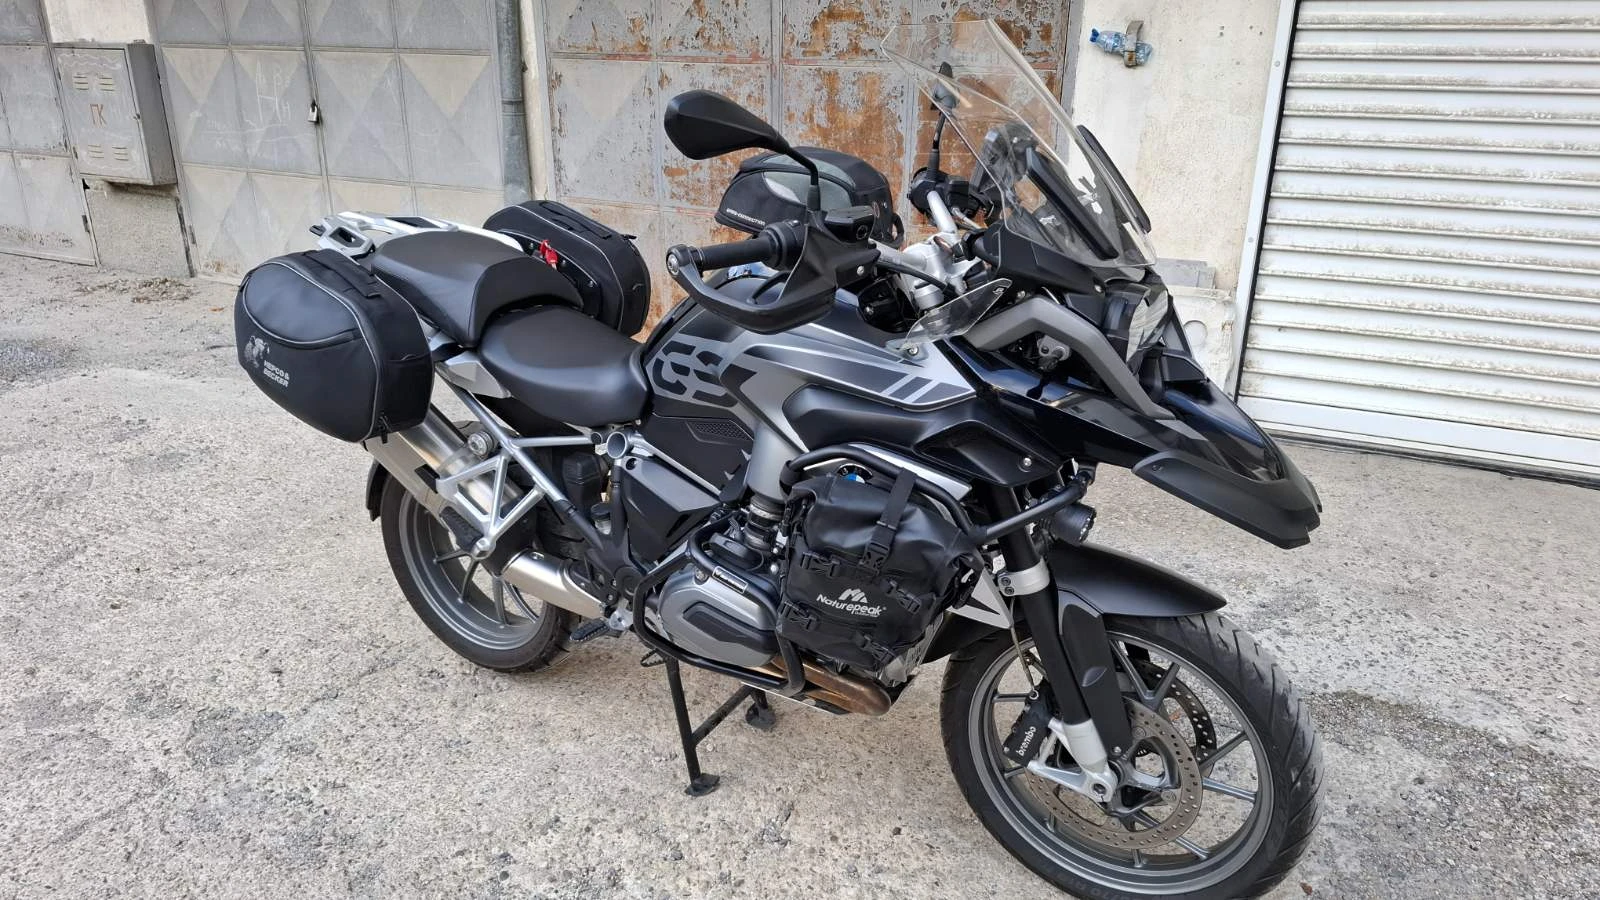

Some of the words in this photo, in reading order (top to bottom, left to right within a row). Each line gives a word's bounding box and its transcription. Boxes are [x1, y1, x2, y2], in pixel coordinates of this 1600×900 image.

[652, 340, 739, 408] GS
[816, 593, 882, 616] Naturepeak
[1015, 726, 1036, 757] brembo
